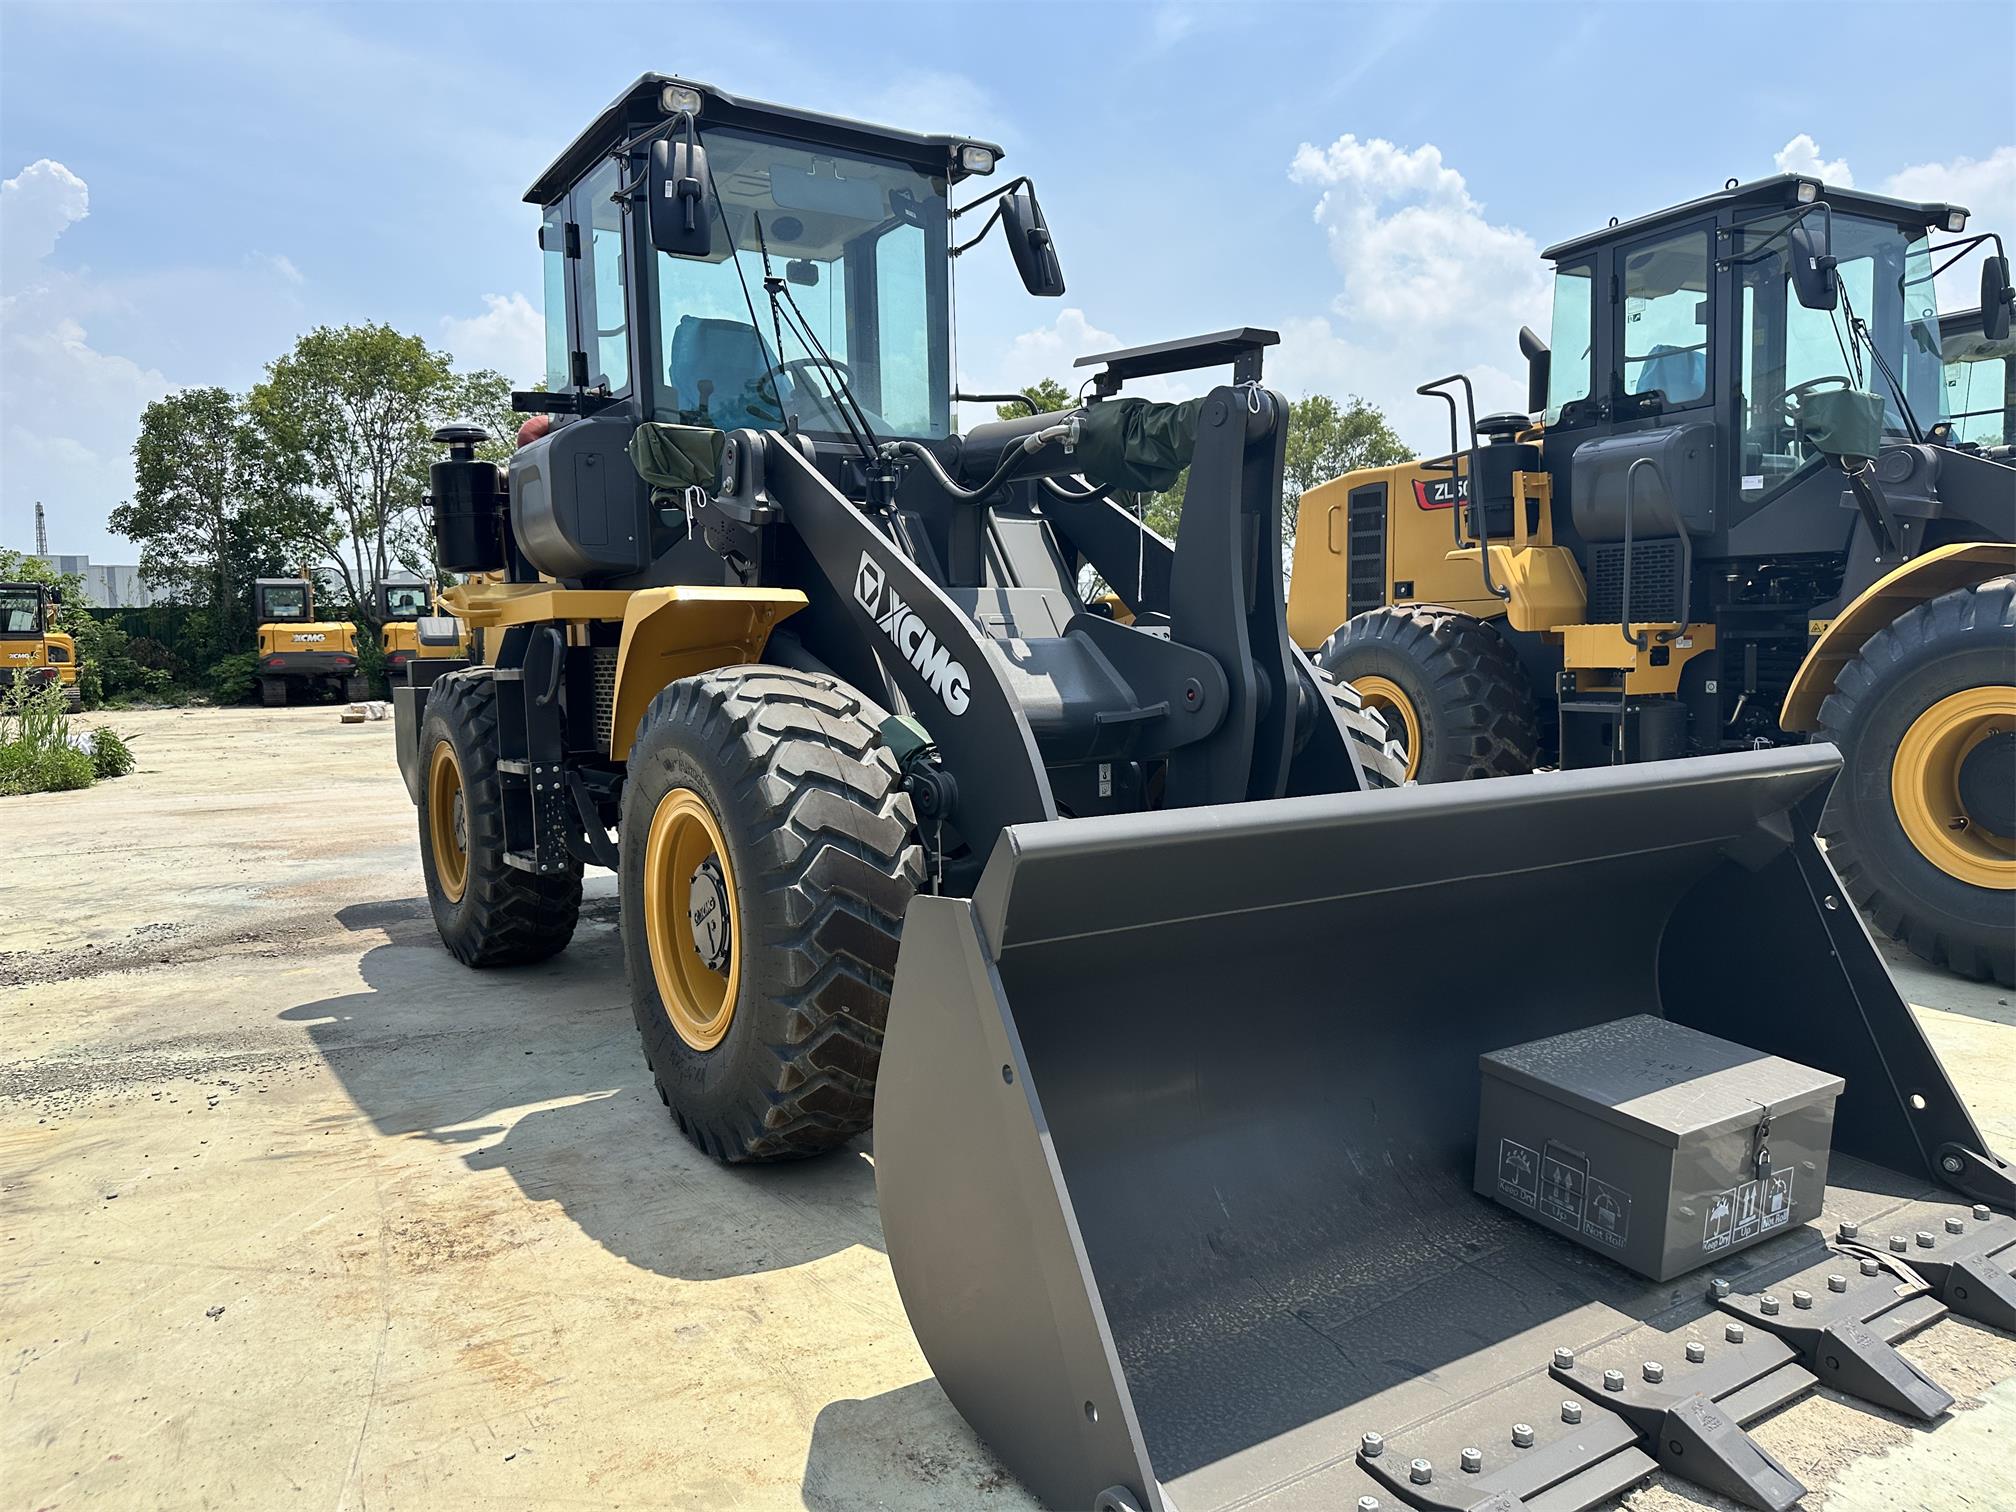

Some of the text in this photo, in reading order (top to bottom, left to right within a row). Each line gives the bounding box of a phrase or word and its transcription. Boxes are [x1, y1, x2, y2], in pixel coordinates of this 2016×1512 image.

[292, 633, 326, 642] XCMG
[876, 585, 971, 716] XCMG
[1499, 1181, 1534, 1205] Keep Dry
[1552, 1206, 1567, 1220] Up
[1585, 1221, 1625, 1249] Not Roll
[1740, 1226, 1751, 1237] Up
[1719, 1234, 1730, 1245] Dry
